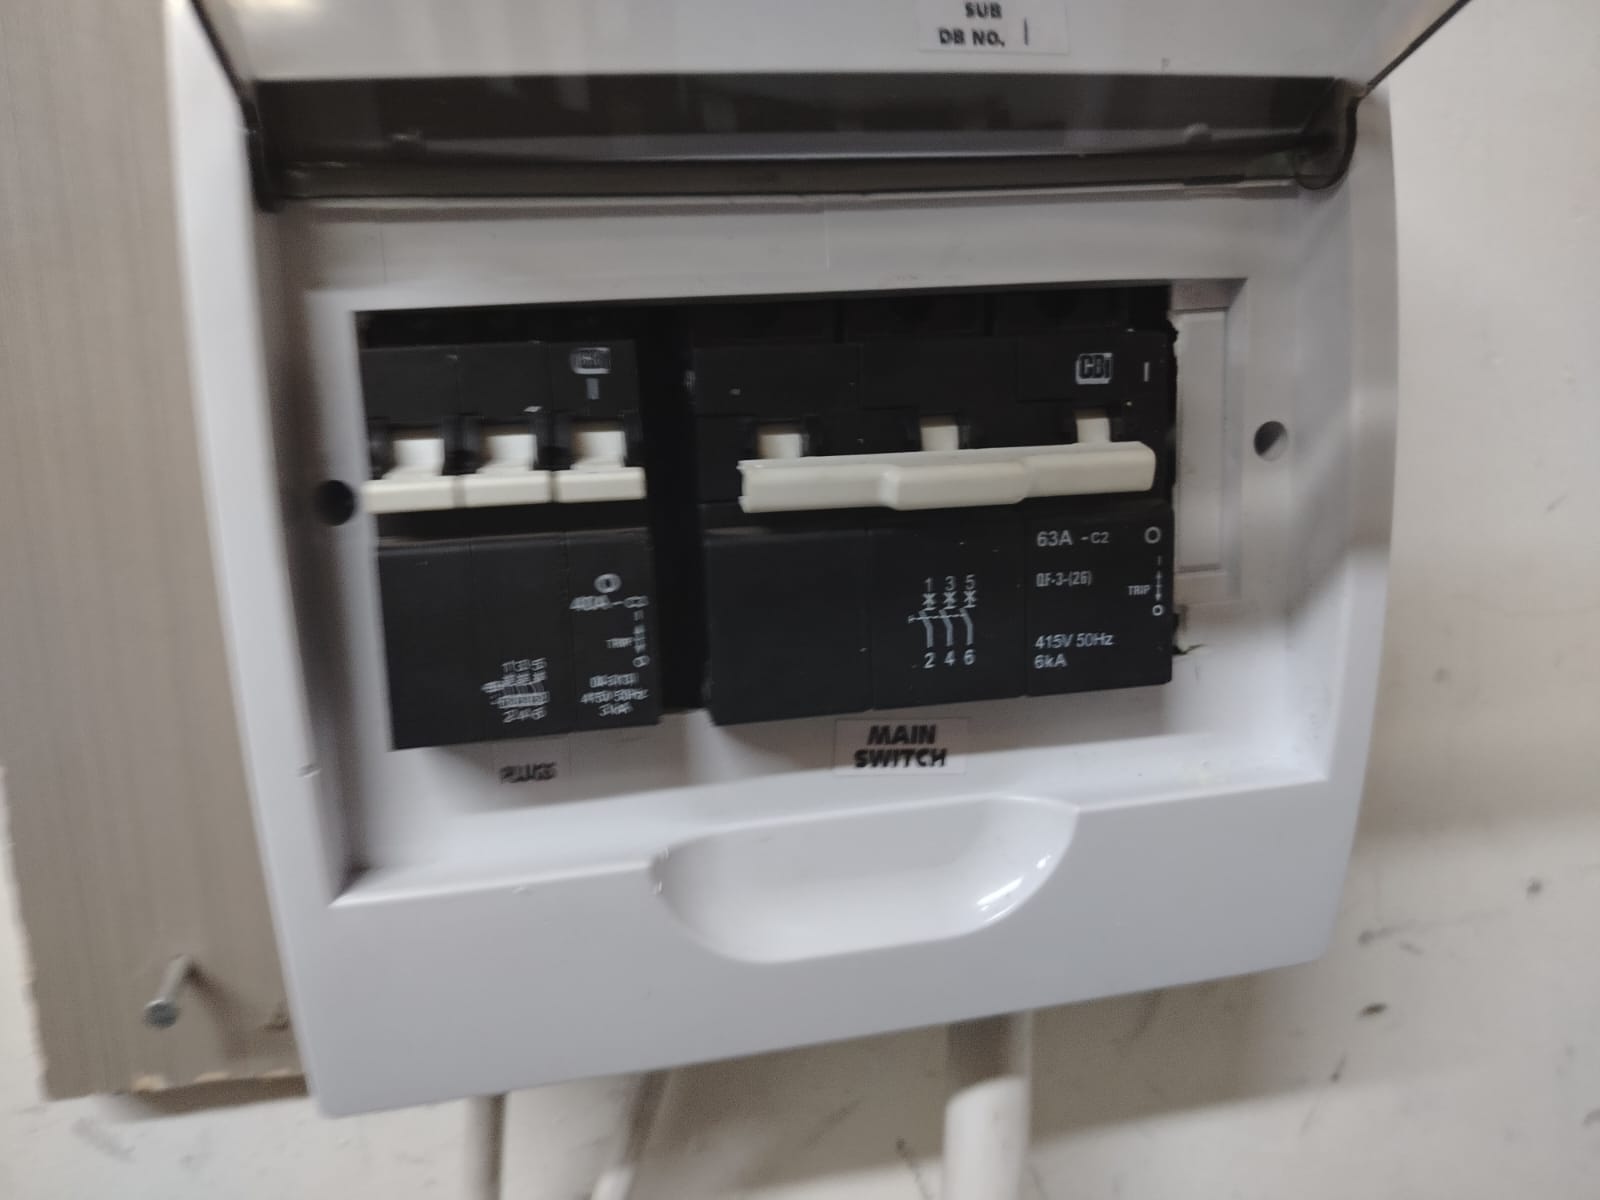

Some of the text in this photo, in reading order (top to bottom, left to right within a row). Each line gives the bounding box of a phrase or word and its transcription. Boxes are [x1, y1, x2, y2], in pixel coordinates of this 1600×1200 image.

[965, 2, 1002, 18] SUB
[938, 28, 965, 45] DB
[1037, 530, 1073, 546] 63A
[1128, 585, 1151, 595] TRIP
[1035, 633, 1115, 648] 415V 50Hz
[923, 650, 976, 669] 2 4 6
[1034, 654, 1068, 668] 6kA
[867, 725, 937, 744] MAIN
[854, 748, 947, 768] SWITCH
